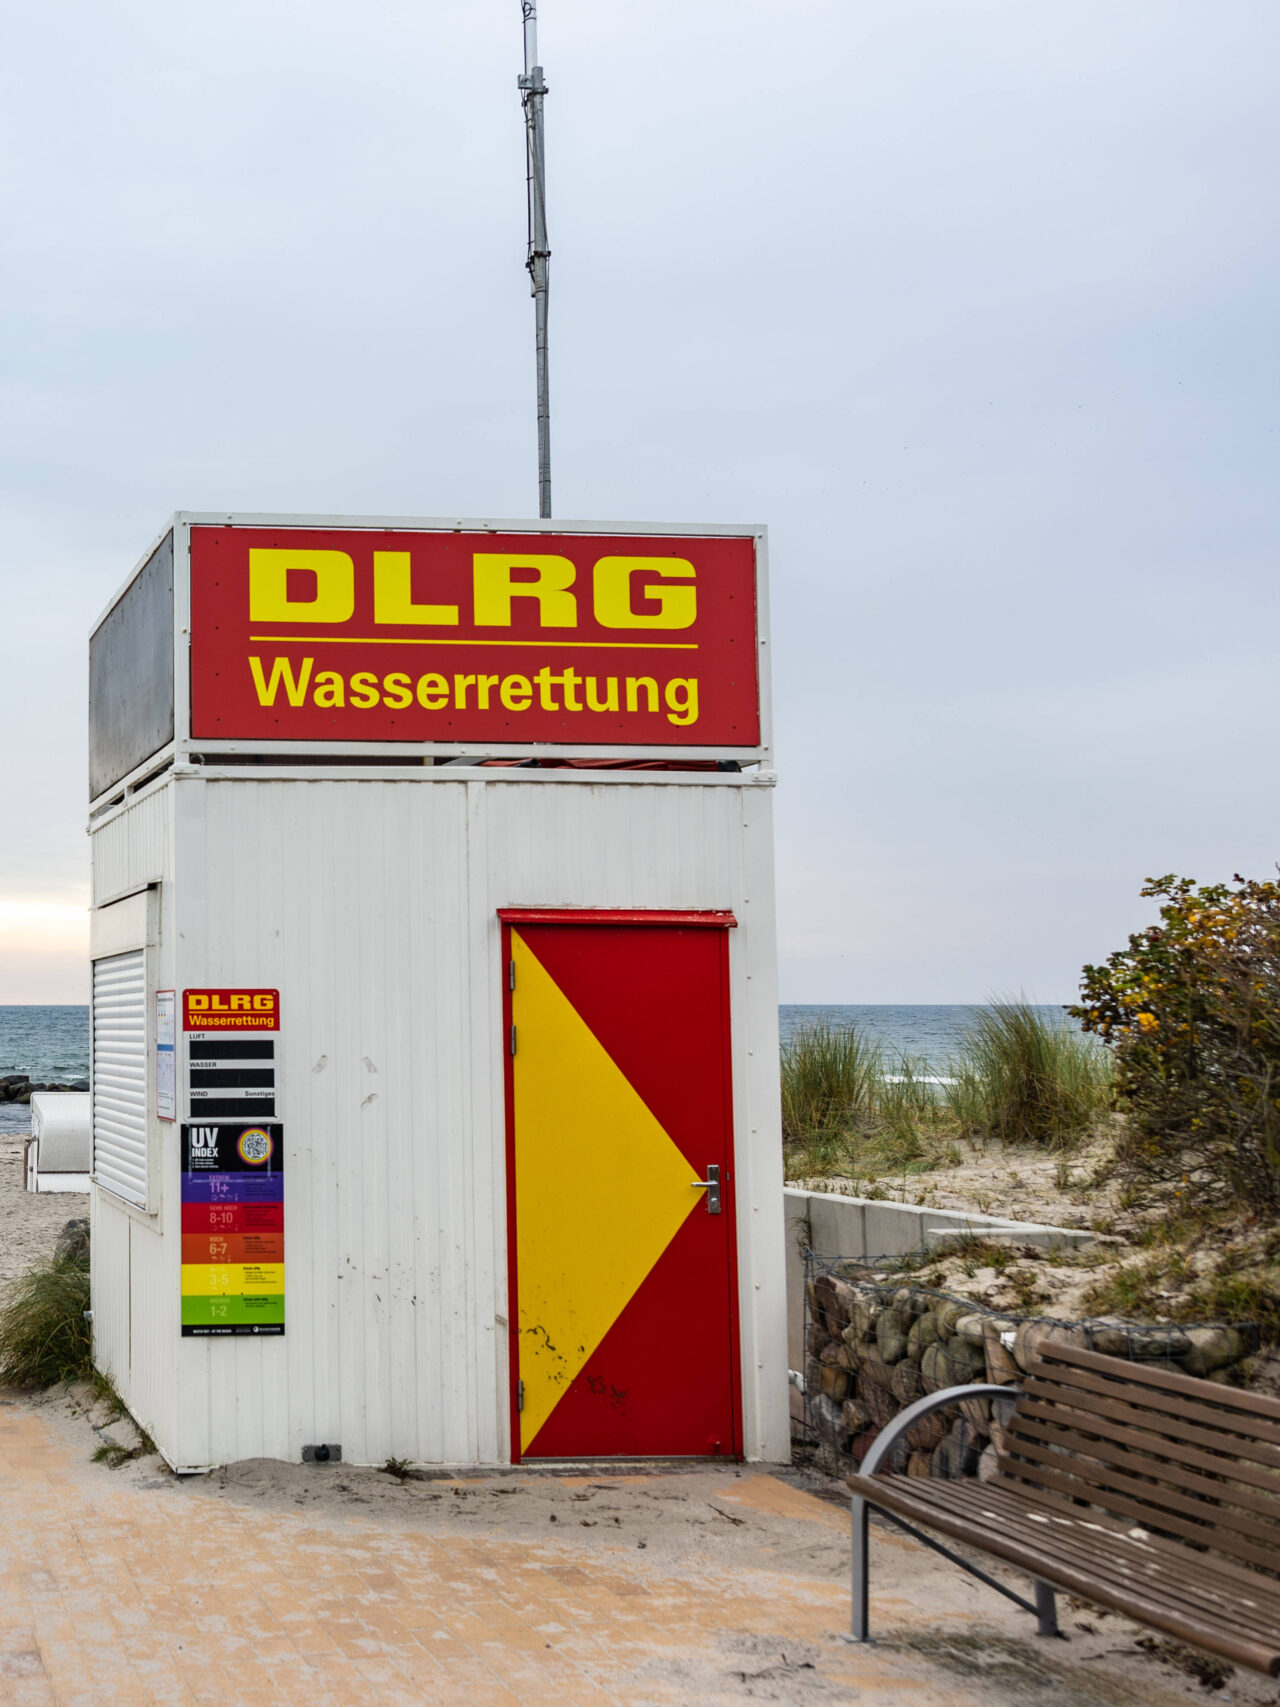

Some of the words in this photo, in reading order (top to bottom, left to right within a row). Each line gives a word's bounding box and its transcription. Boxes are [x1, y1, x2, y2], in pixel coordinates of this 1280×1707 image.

[249, 548, 697, 630] DLRG
[248, 656, 699, 726] Wasserrettung
[188, 994, 274, 1010] DLRG
[189, 1015, 275, 1028] Wasserrettung
[244, 1090, 275, 1098] Sonstiges
[192, 1127, 219, 1148] UV
[192, 1148, 219, 1157] INDEX
[209, 1181, 229, 1193] 11+
[209, 1212, 233, 1224] 8-10
[209, 1243, 228, 1255] 6-7
[209, 1274, 229, 1286] 3-5
[210, 1305, 228, 1317] 1-2
